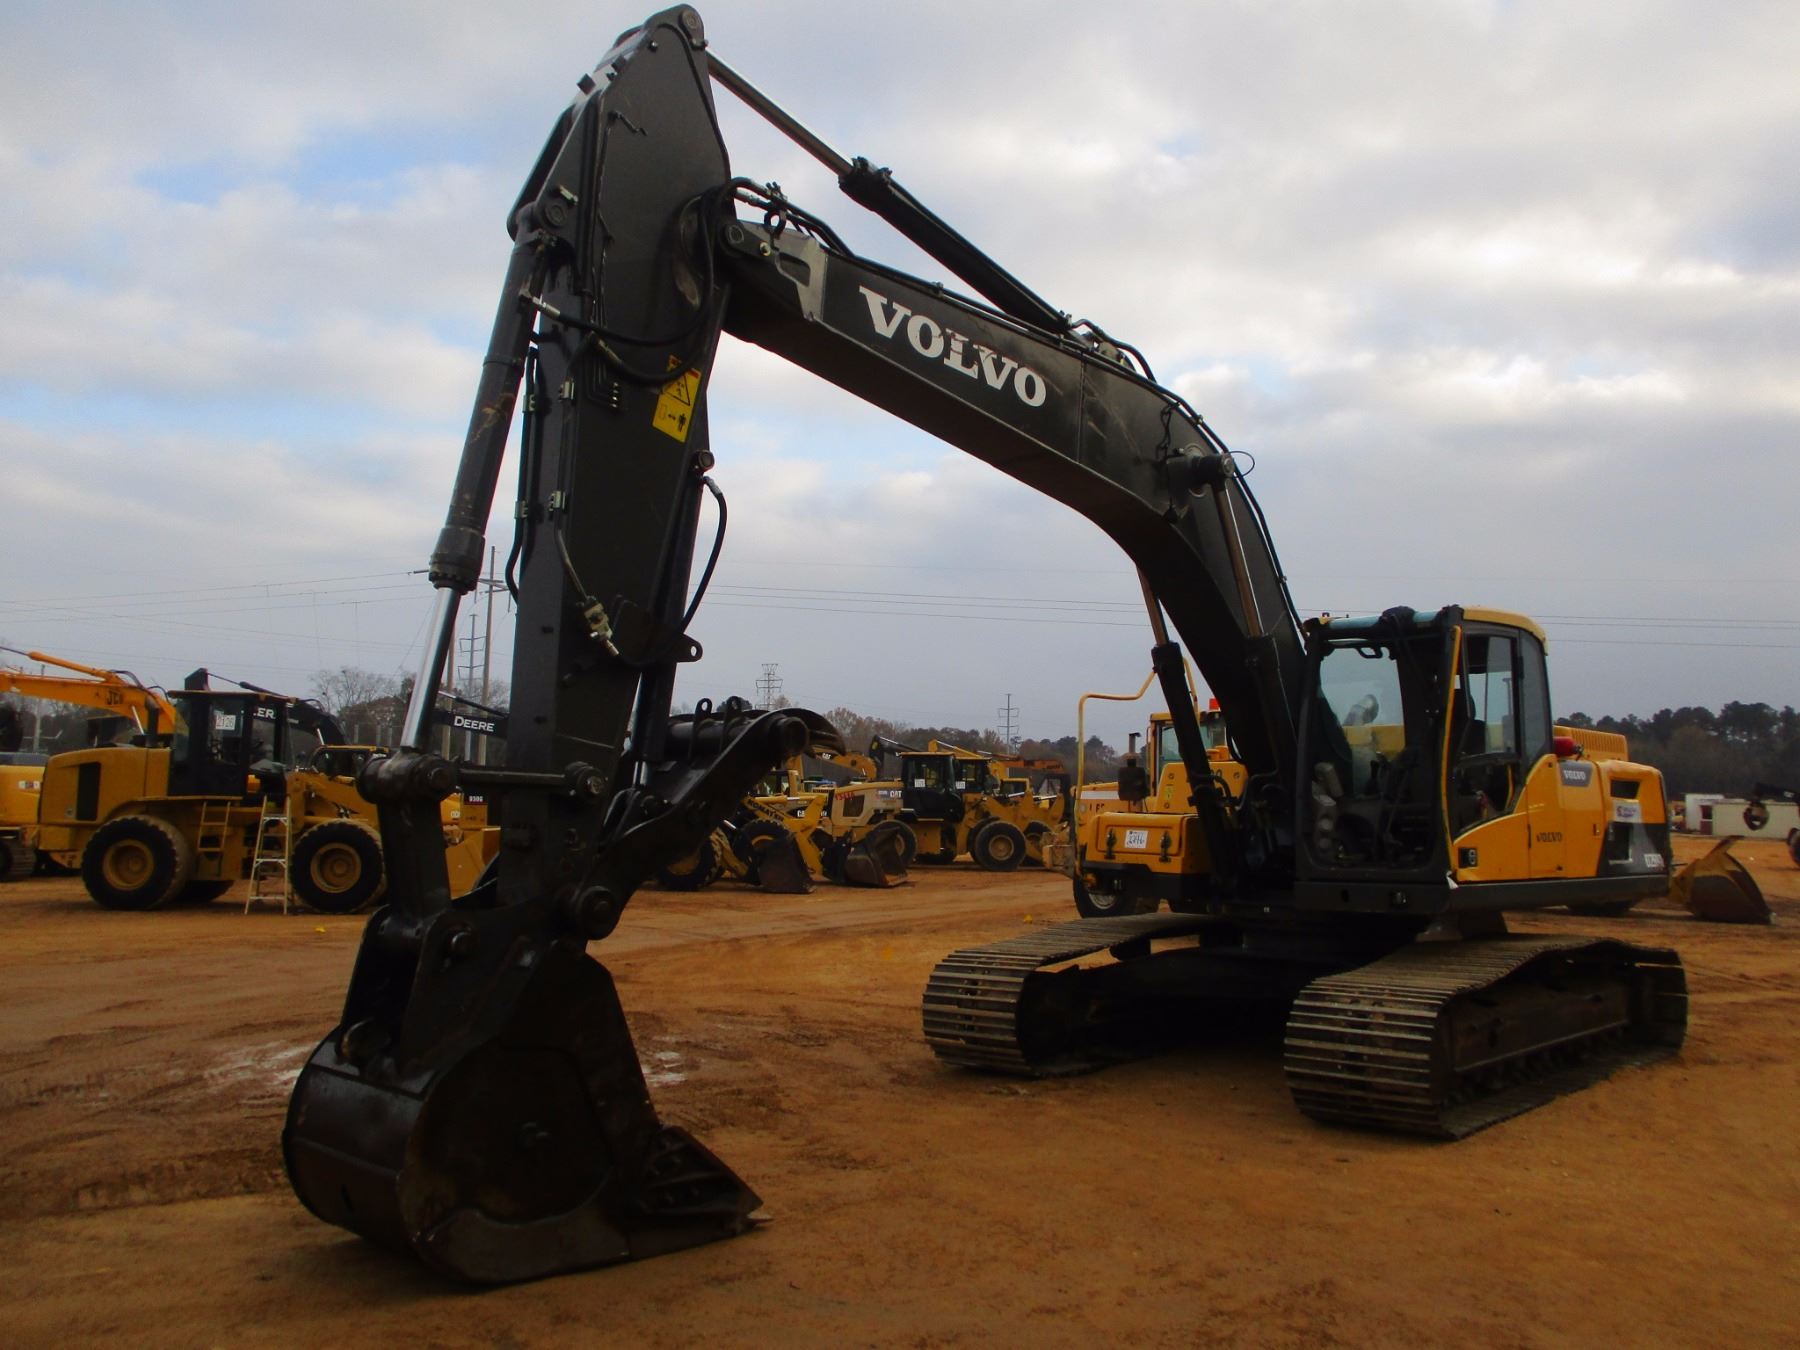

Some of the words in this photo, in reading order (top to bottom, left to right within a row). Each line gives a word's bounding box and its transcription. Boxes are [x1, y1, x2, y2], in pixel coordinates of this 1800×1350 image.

[859, 285, 1047, 408] VOLVO
[453, 715, 495, 732] DEERE
[1563, 769, 1586, 781] VOLVO
[1536, 832, 1562, 843] VOLVO
